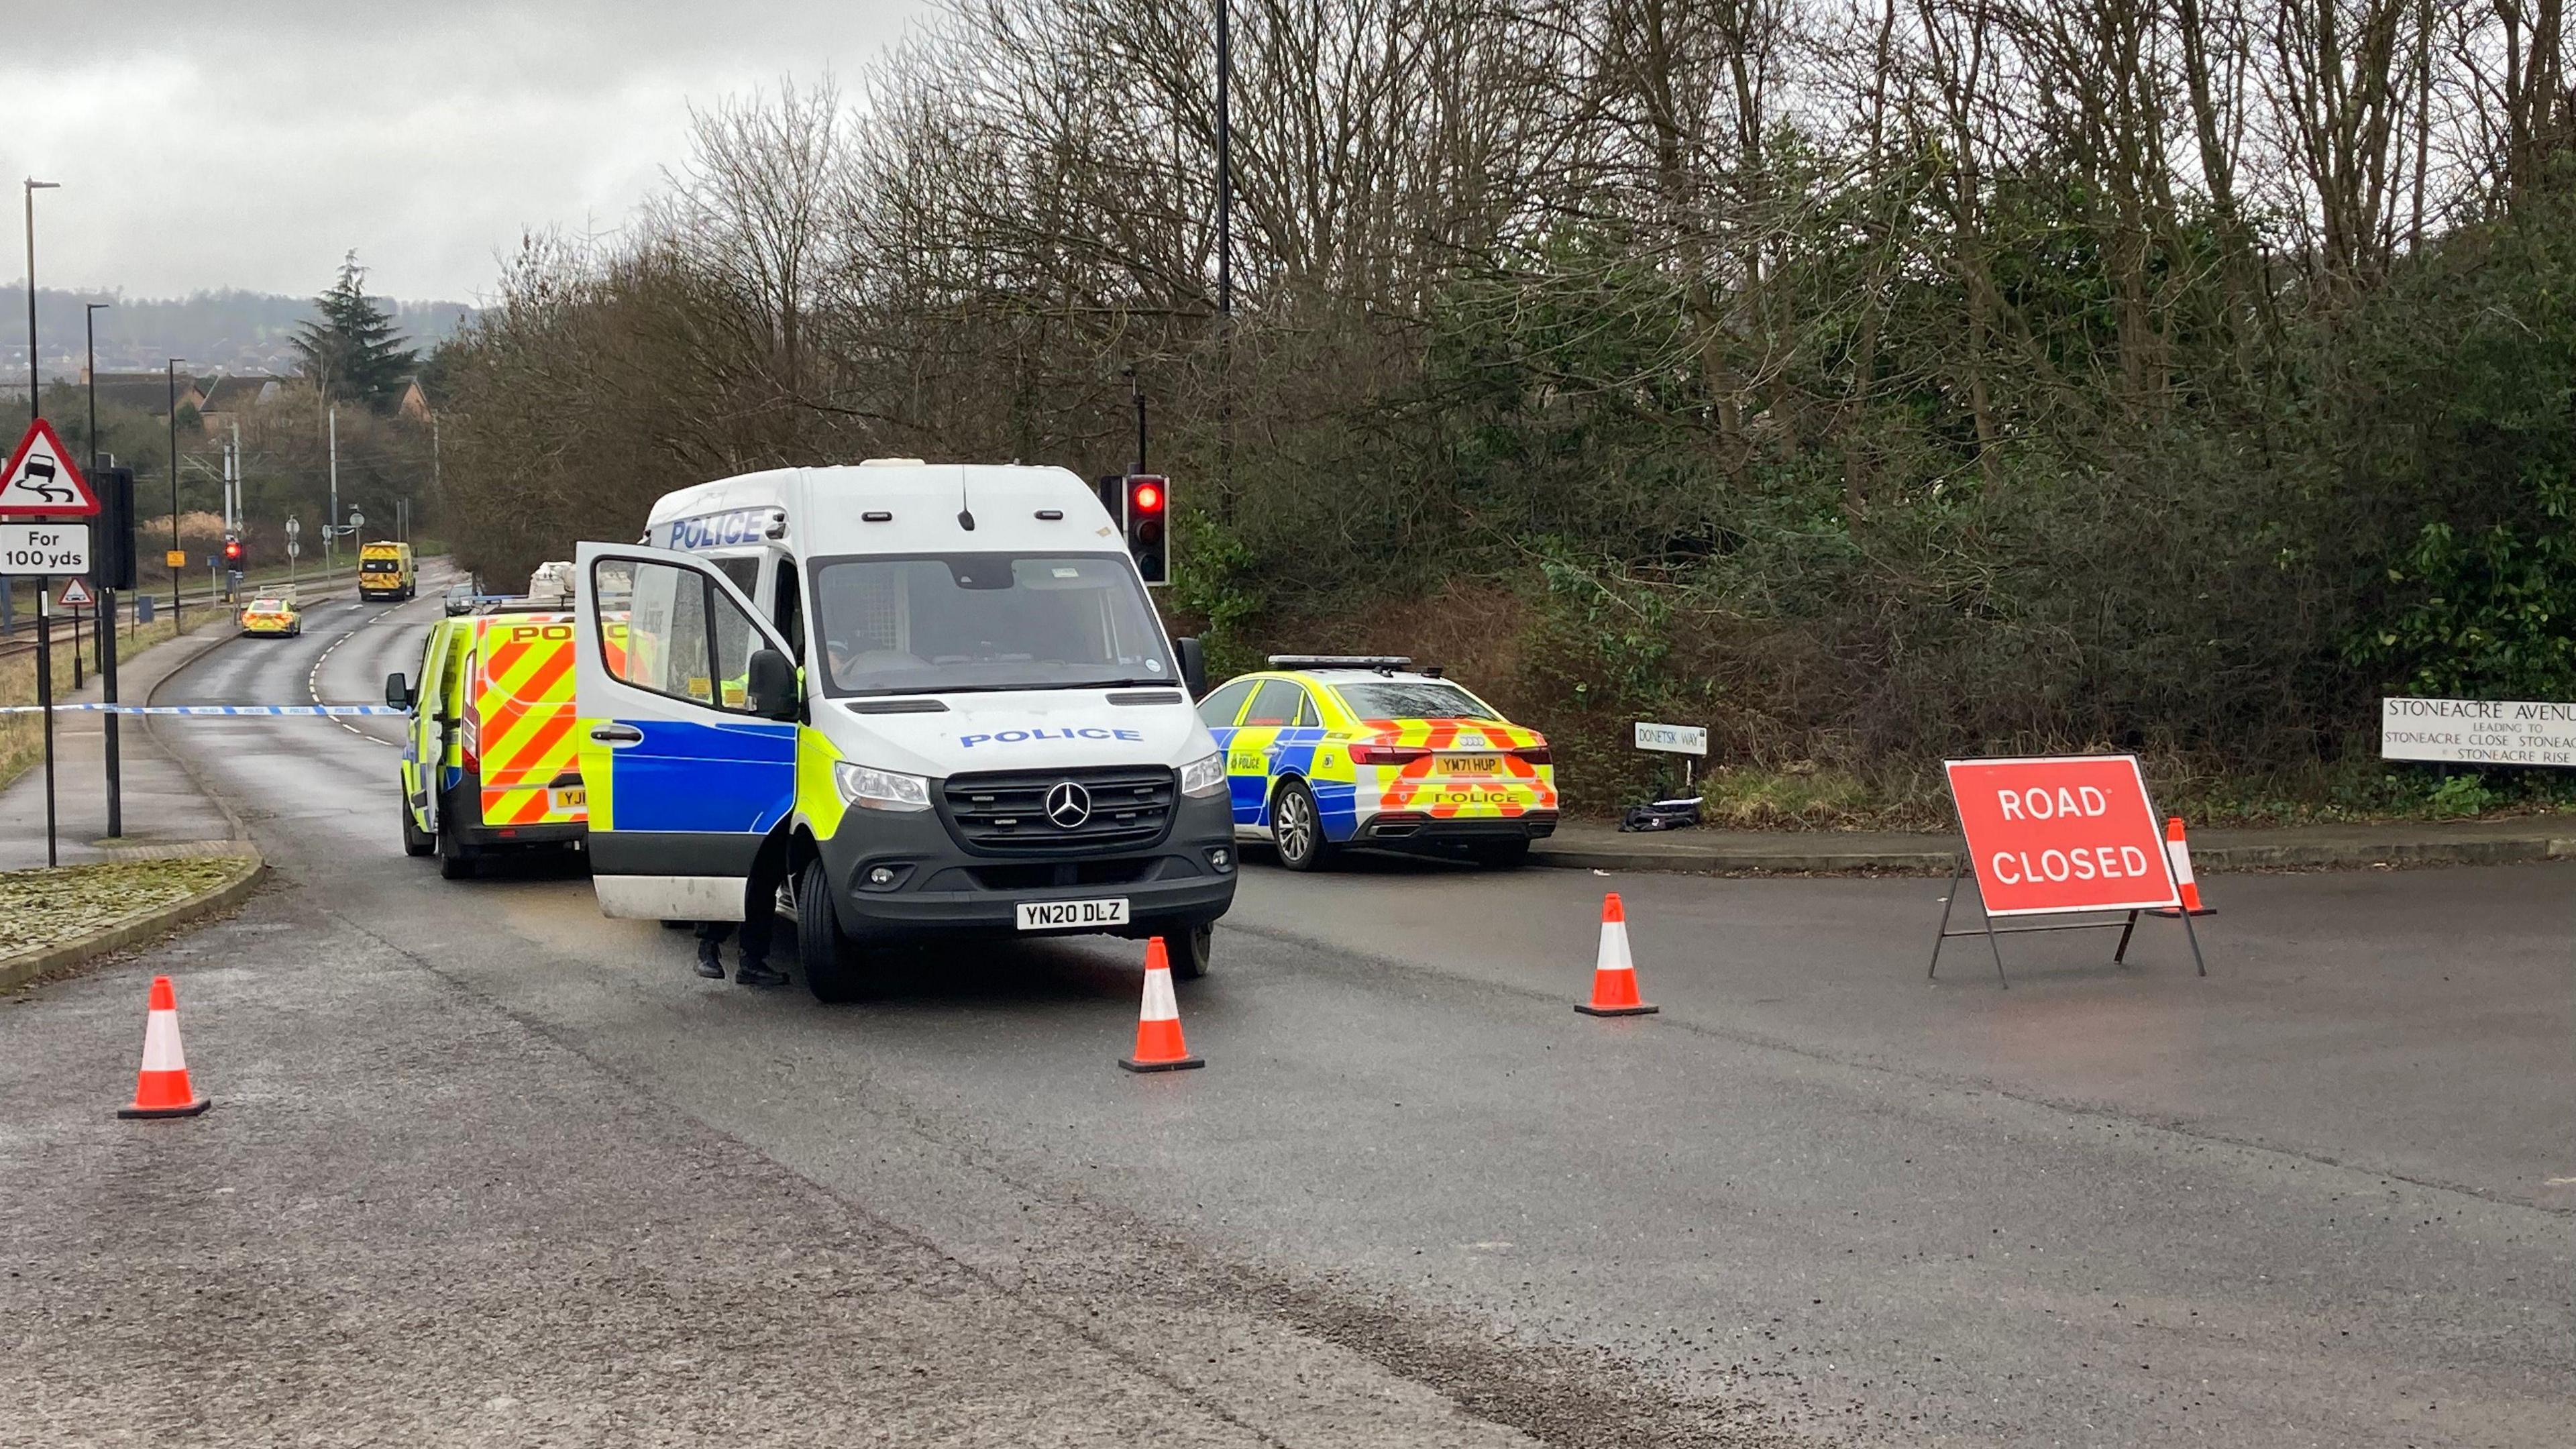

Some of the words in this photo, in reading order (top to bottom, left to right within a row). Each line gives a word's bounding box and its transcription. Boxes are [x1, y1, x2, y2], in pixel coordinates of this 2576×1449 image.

[29, 531, 59, 545] For
[670, 510, 766, 549] POLICE
[6, 551, 44, 565] 100
[48, 551, 82, 568] yds
[2388, 699, 2504, 719] STONEACRE
[2473, 722, 2522, 733] LEADING
[2529, 723, 2543, 734] TO
[960, 727, 1144, 748] POLICE
[1639, 729, 1677, 744] DONETSK
[1680, 731, 1699, 747] WAY
[2385, 732, 2462, 745] STONEACRE
[2469, 734, 2509, 746] CLOSE
[1238, 757, 1260, 769] POLICE
[2458, 748, 2535, 762] STONEACRE
[2543, 752, 2571, 763] RISE
[1472, 758, 1496, 771] HUP
[1435, 792, 1520, 803] POLICE
[1997, 786, 2106, 820] ROAD
[1992, 845, 2148, 885] CLOSED
[1026, 904, 1077, 925] YN20
[1083, 902, 1121, 922] DLZ
